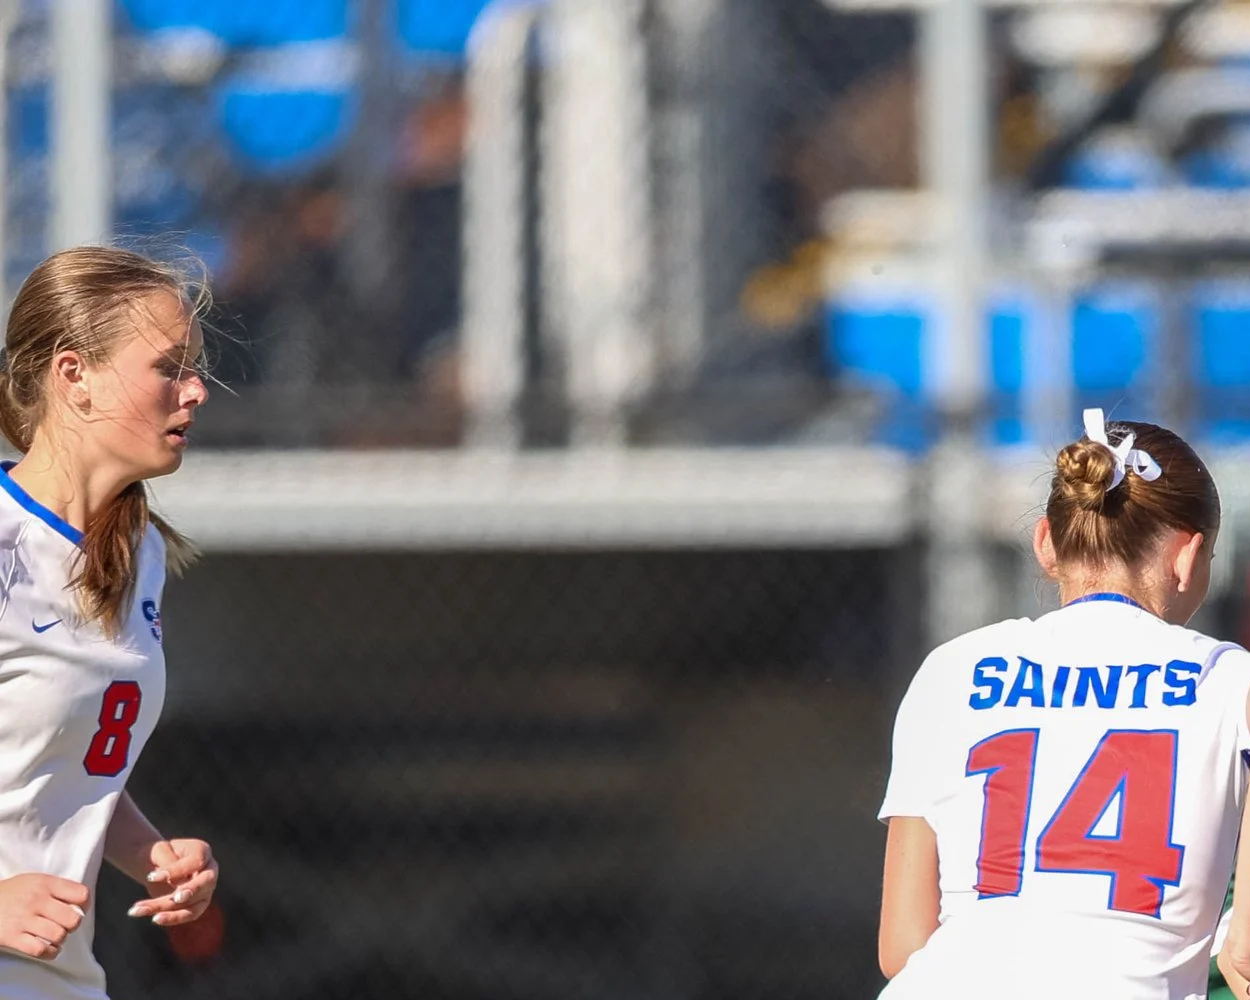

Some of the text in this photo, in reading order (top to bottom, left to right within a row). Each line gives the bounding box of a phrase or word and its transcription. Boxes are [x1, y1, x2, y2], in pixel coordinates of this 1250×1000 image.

[83, 680, 142, 777] 8
[968, 655, 1203, 711] SAINTS
[965, 727, 1186, 920] 14
